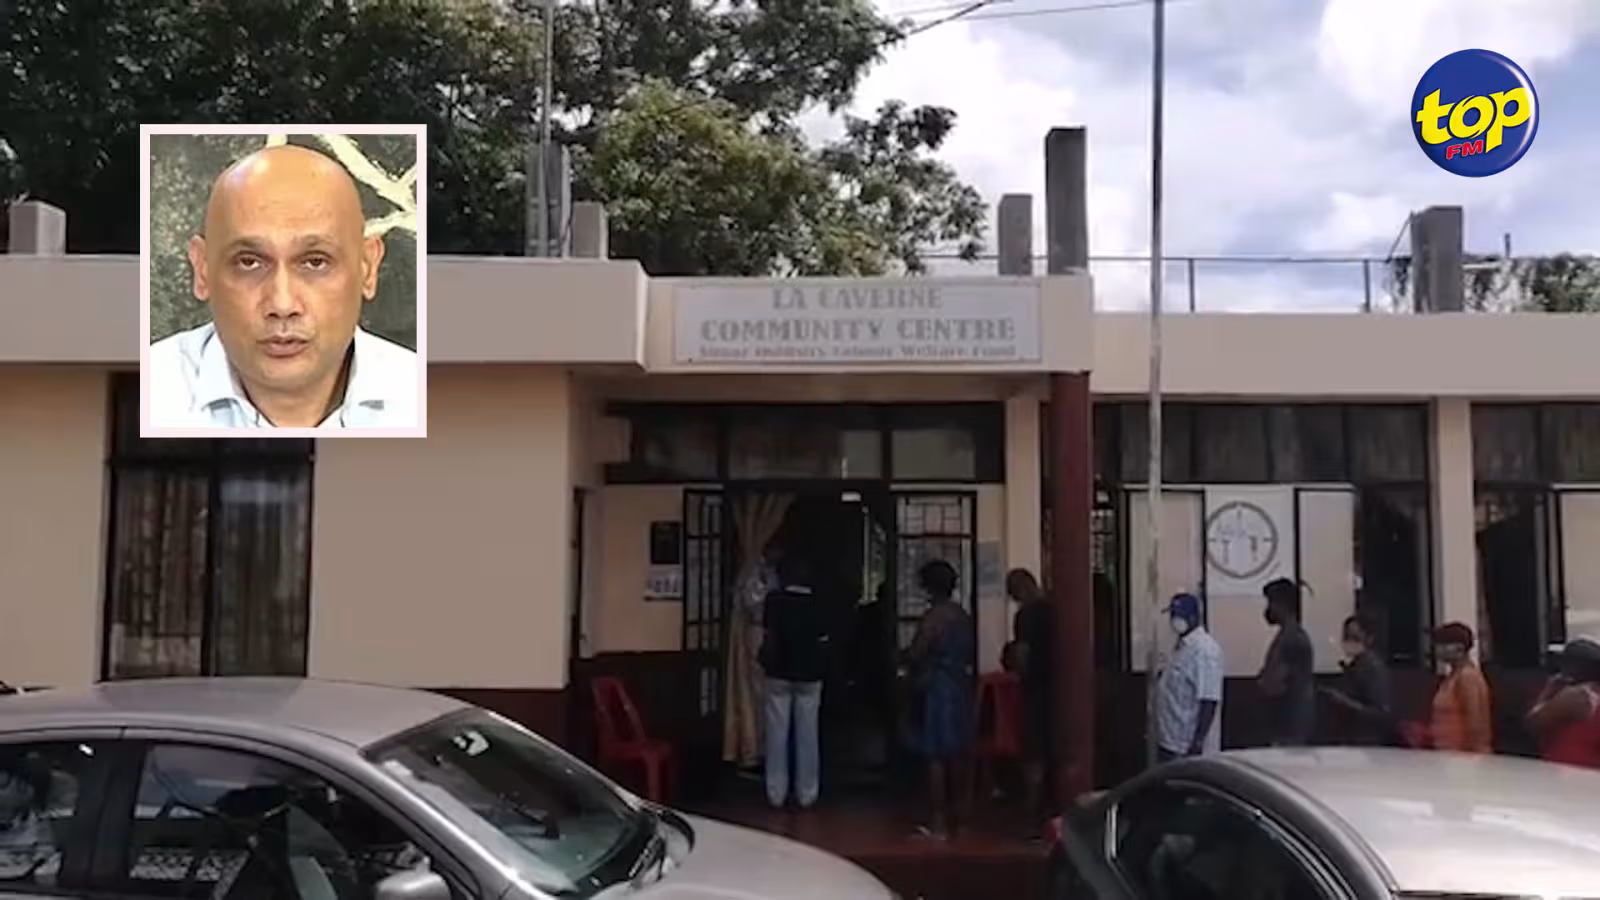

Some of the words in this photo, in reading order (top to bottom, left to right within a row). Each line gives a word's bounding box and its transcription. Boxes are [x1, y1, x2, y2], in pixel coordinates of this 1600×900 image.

[773, 287, 808, 309] LA
[818, 287, 943, 309] CAVERNE
[701, 319, 884, 341] COMMUNITY
[896, 319, 1016, 341] CENTRE
